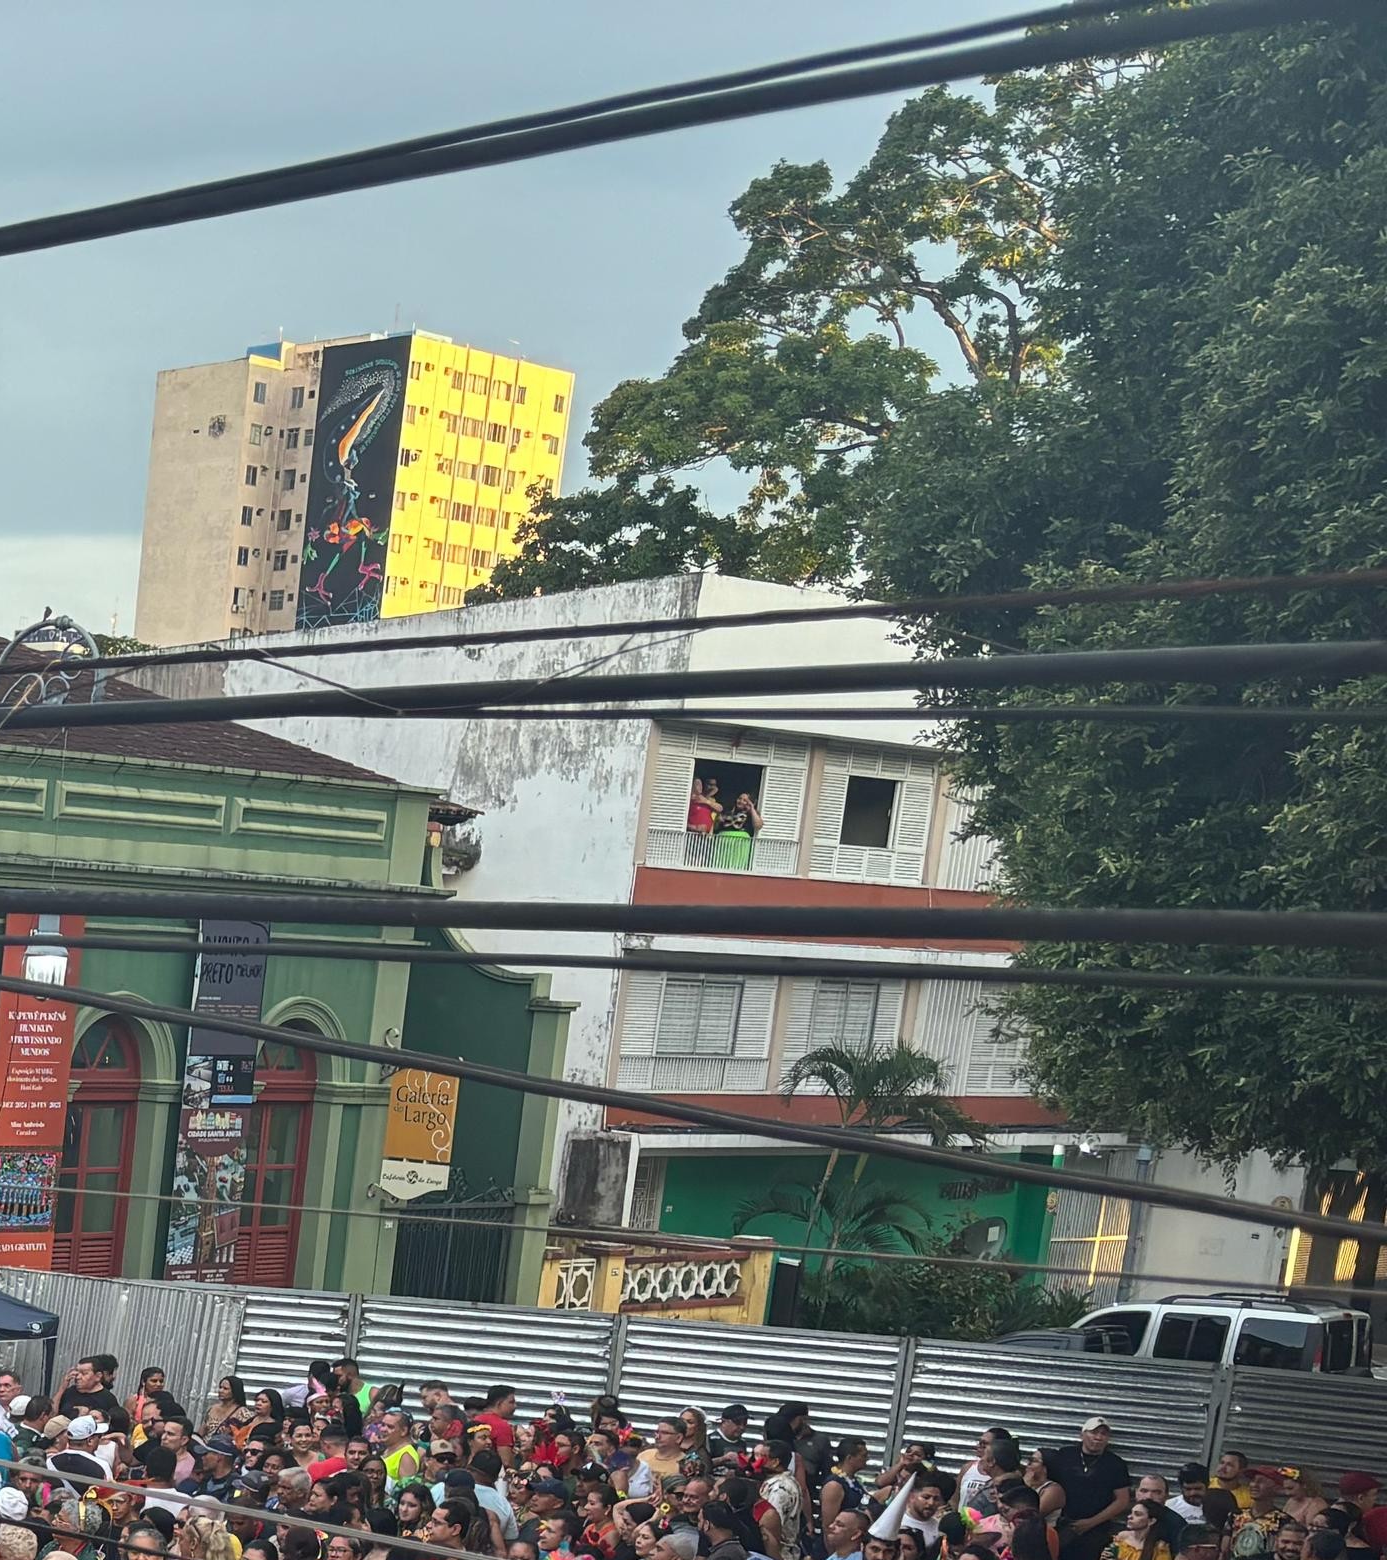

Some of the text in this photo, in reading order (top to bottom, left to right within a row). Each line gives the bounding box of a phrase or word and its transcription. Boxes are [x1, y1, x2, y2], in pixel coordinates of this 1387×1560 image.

[396, 1085, 450, 1106] Galeria
[404, 1105, 448, 1131] Largo
[14, 1243, 47, 1252] GRATUITA
